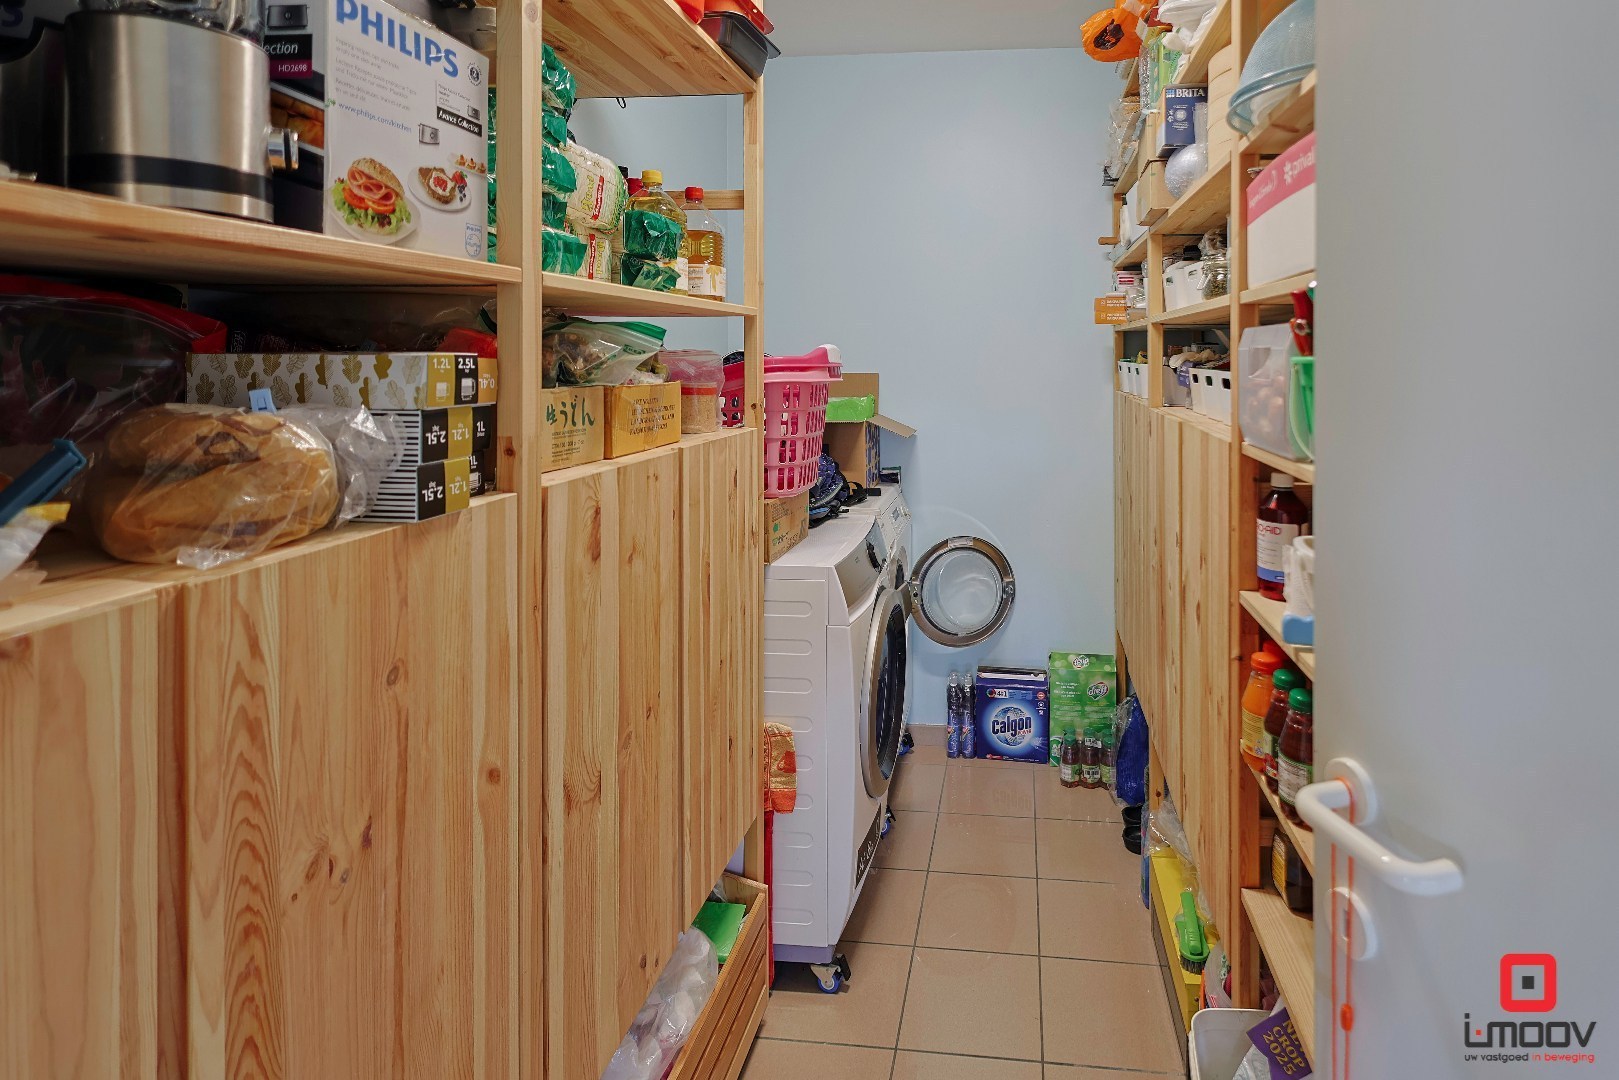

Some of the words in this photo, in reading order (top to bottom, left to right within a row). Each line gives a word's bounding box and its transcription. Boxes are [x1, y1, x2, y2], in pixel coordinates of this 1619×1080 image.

[336, 0, 459, 78] PHILIPS
[278, 64, 307, 72] HD2698
[1175, 88, 1205, 98] BRITA
[432, 357, 451, 369] 1.2L
[458, 357, 476, 369] 2.5L
[479, 378, 495, 389] 0.4L
[476, 420, 485, 431] 1L
[425, 430, 447, 445] 2.5L
[451, 427, 470, 441] 1.2L
[469, 455, 478, 466] 1L
[422, 486, 443, 502] 2.5L
[449, 481, 468, 495] 1.2L
[991, 716, 1032, 737] Calgon
[1262, 1030, 1297, 1075] 2025
[1272, 1026, 1305, 1067] CROP
